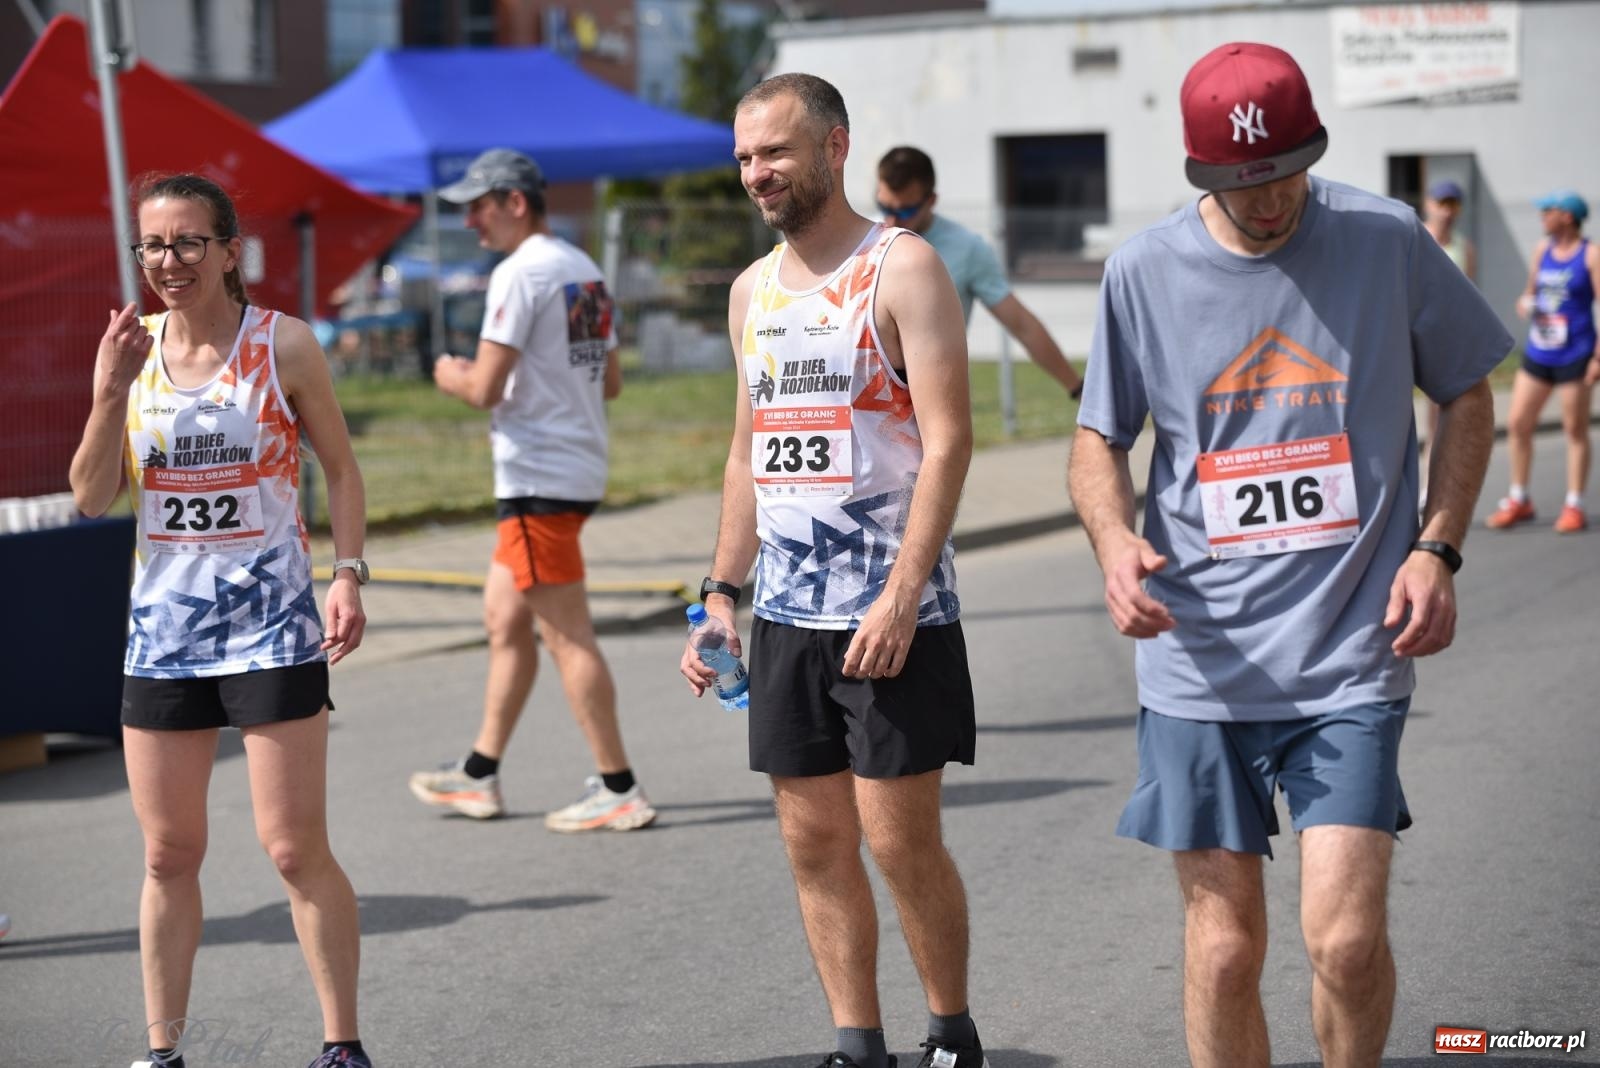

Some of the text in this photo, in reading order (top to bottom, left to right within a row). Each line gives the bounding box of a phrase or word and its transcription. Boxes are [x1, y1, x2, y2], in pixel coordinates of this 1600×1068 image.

[1228, 101, 1269, 145] NY
[782, 358, 826, 377] XII BIEG
[779, 372, 852, 395] KOZIOŁKÓW
[786, 410, 799, 419] BEZ
[800, 409, 837, 418] GRANIC
[1206, 388, 1347, 415] NIKE TRAIL
[174, 432, 225, 451] XII BIEG
[765, 435, 831, 473] 233
[1214, 456, 1234, 467] XVI
[1235, 452, 1261, 464] BIEG
[1262, 448, 1283, 460] BEZ
[1284, 441, 1330, 457] GRANIC
[173, 444, 253, 468] KOZIOŁKÓW
[155, 468, 242, 481] XVI BIEG BEZ GRANIC
[164, 494, 242, 532] 232
[1235, 475, 1324, 527] 216
